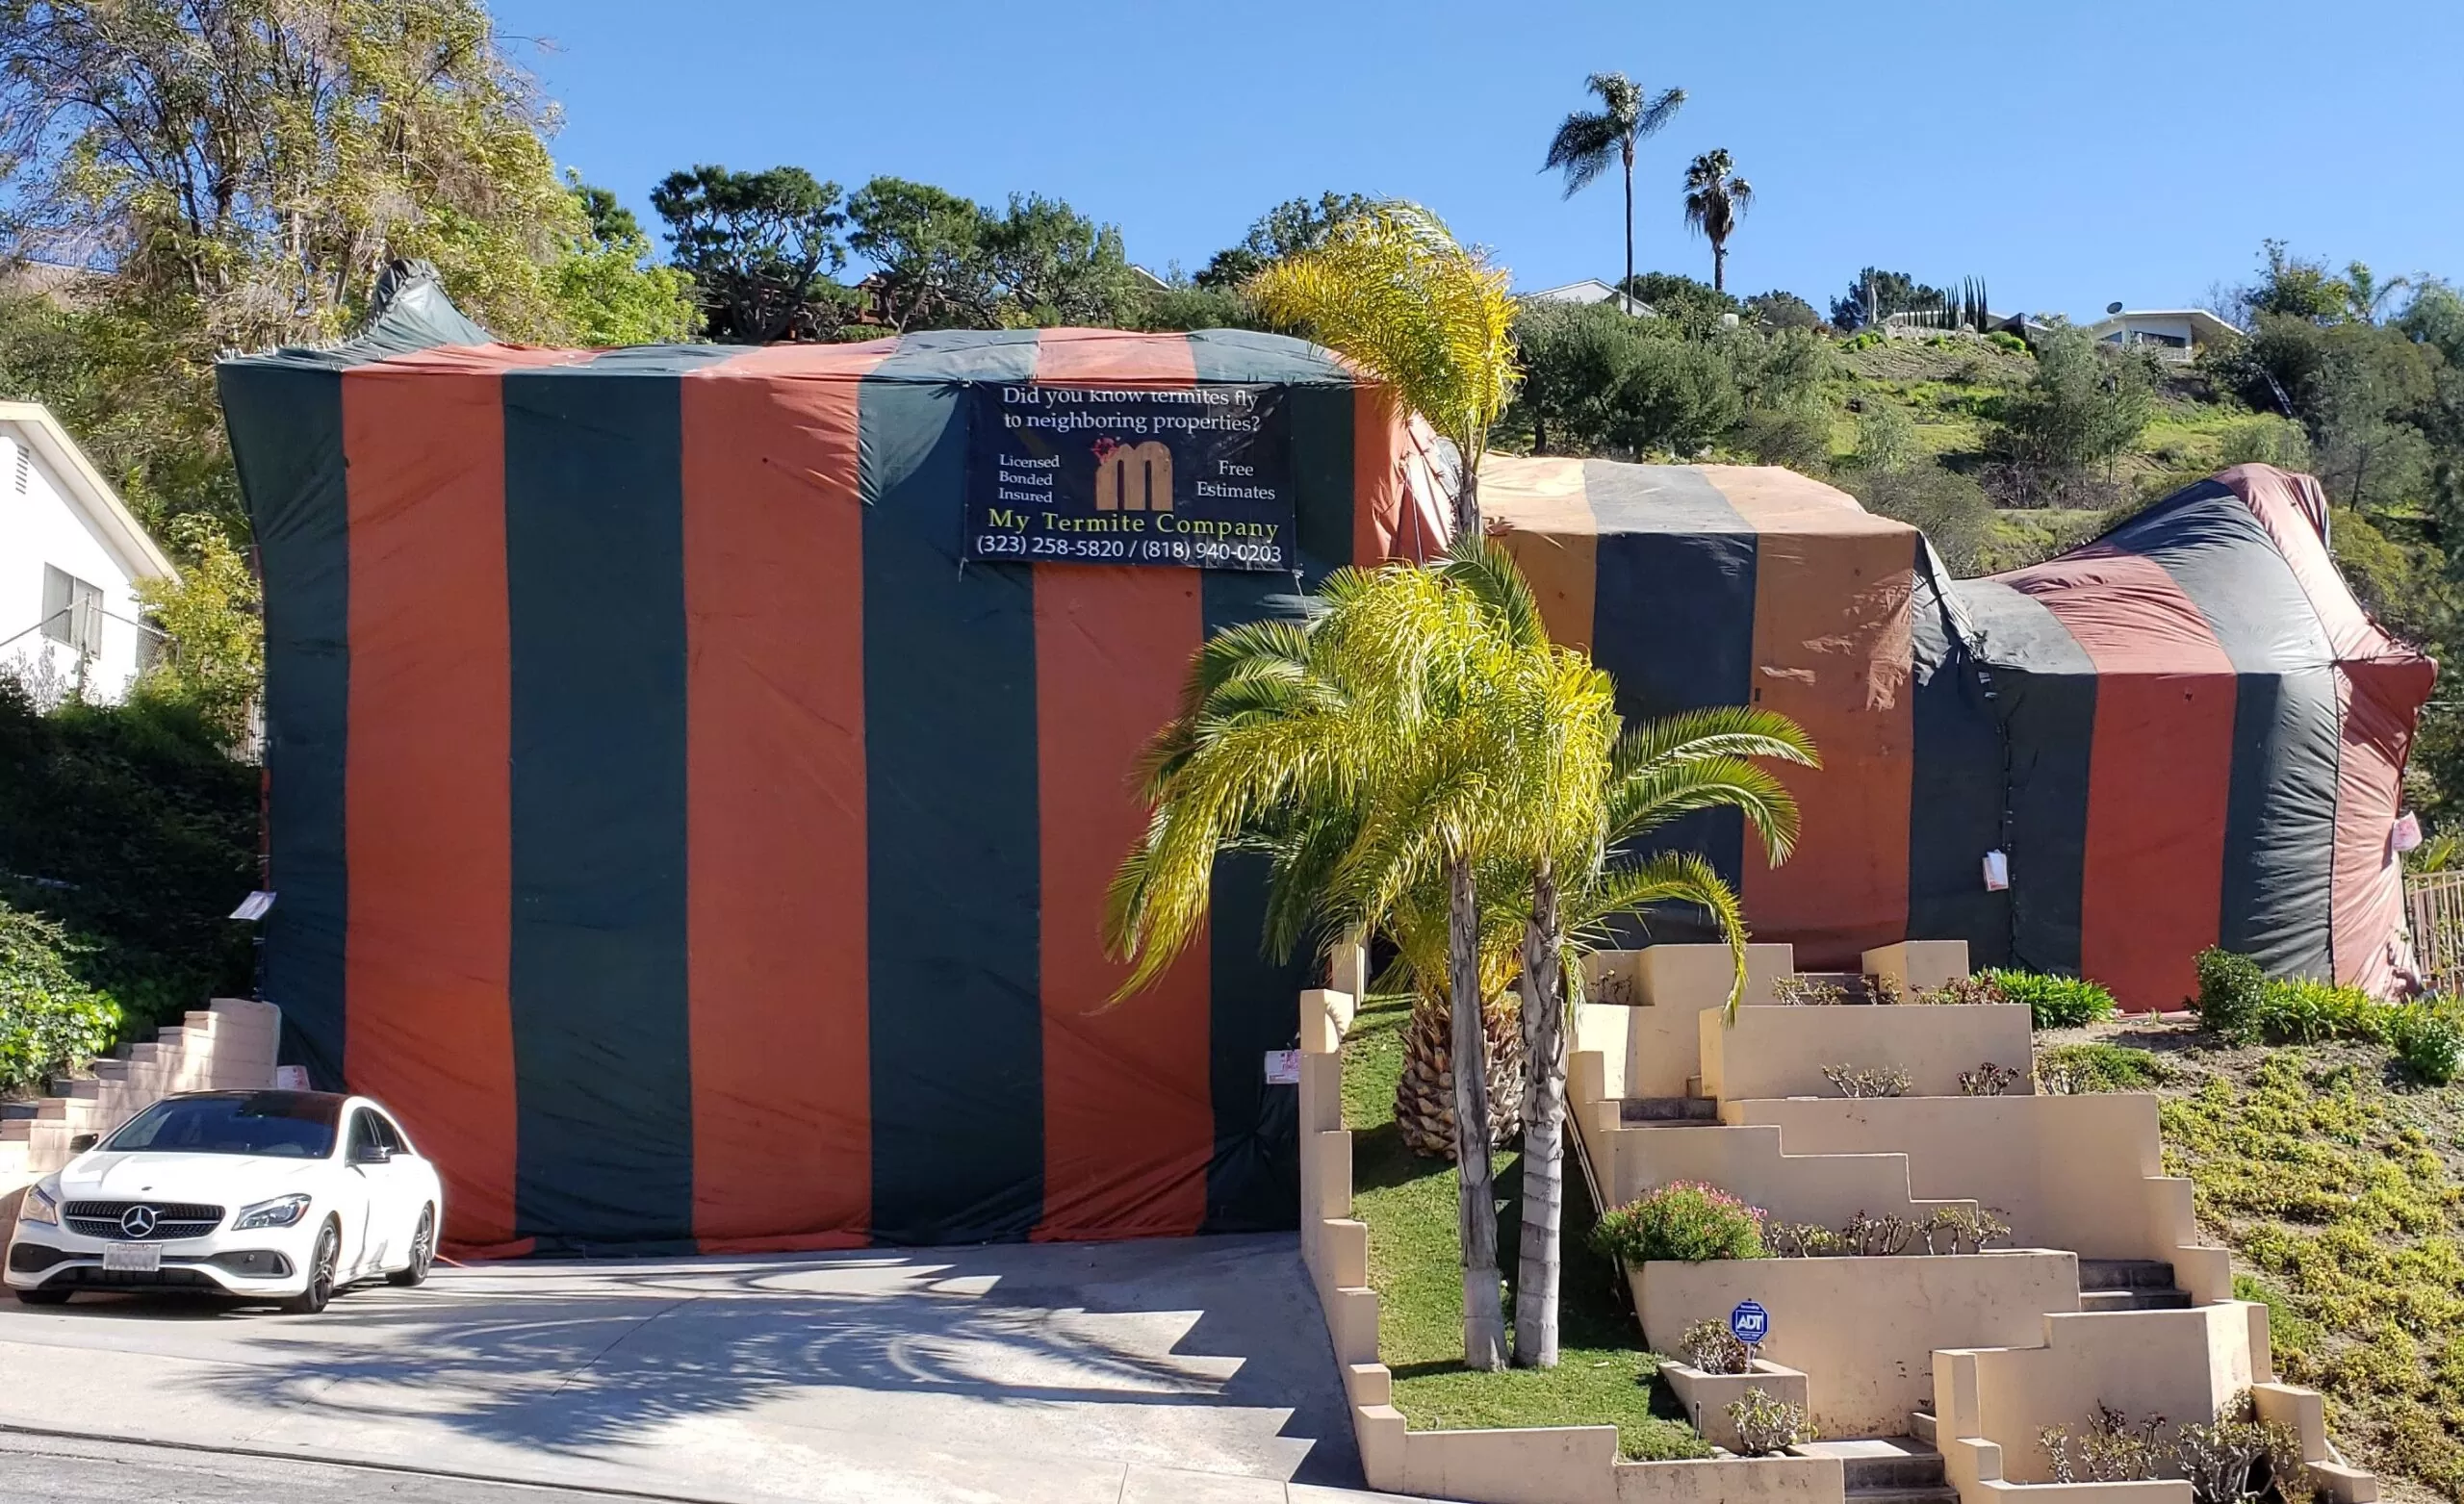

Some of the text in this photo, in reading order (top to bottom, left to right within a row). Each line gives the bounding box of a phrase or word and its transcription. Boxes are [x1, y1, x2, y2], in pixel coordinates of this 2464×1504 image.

[1003, 387, 1259, 412] Did you know termites fly
[1003, 412, 1261, 433] to neighboring properties?
[999, 454, 1061, 469] Licensed
[1218, 460, 1254, 476] Free
[998, 471, 1053, 486] Bonded
[998, 488, 1053, 504] Insured
[1196, 481, 1276, 500] Estimates
[988, 508, 1279, 544] My Termite Company
[977, 534, 1026, 554] (323)
[1032, 537, 1124, 557] 258-5820
[1142, 542, 1191, 560] (818)
[1195, 543, 1282, 562] 940-0203
[1737, 1314, 1763, 1330] ADT
